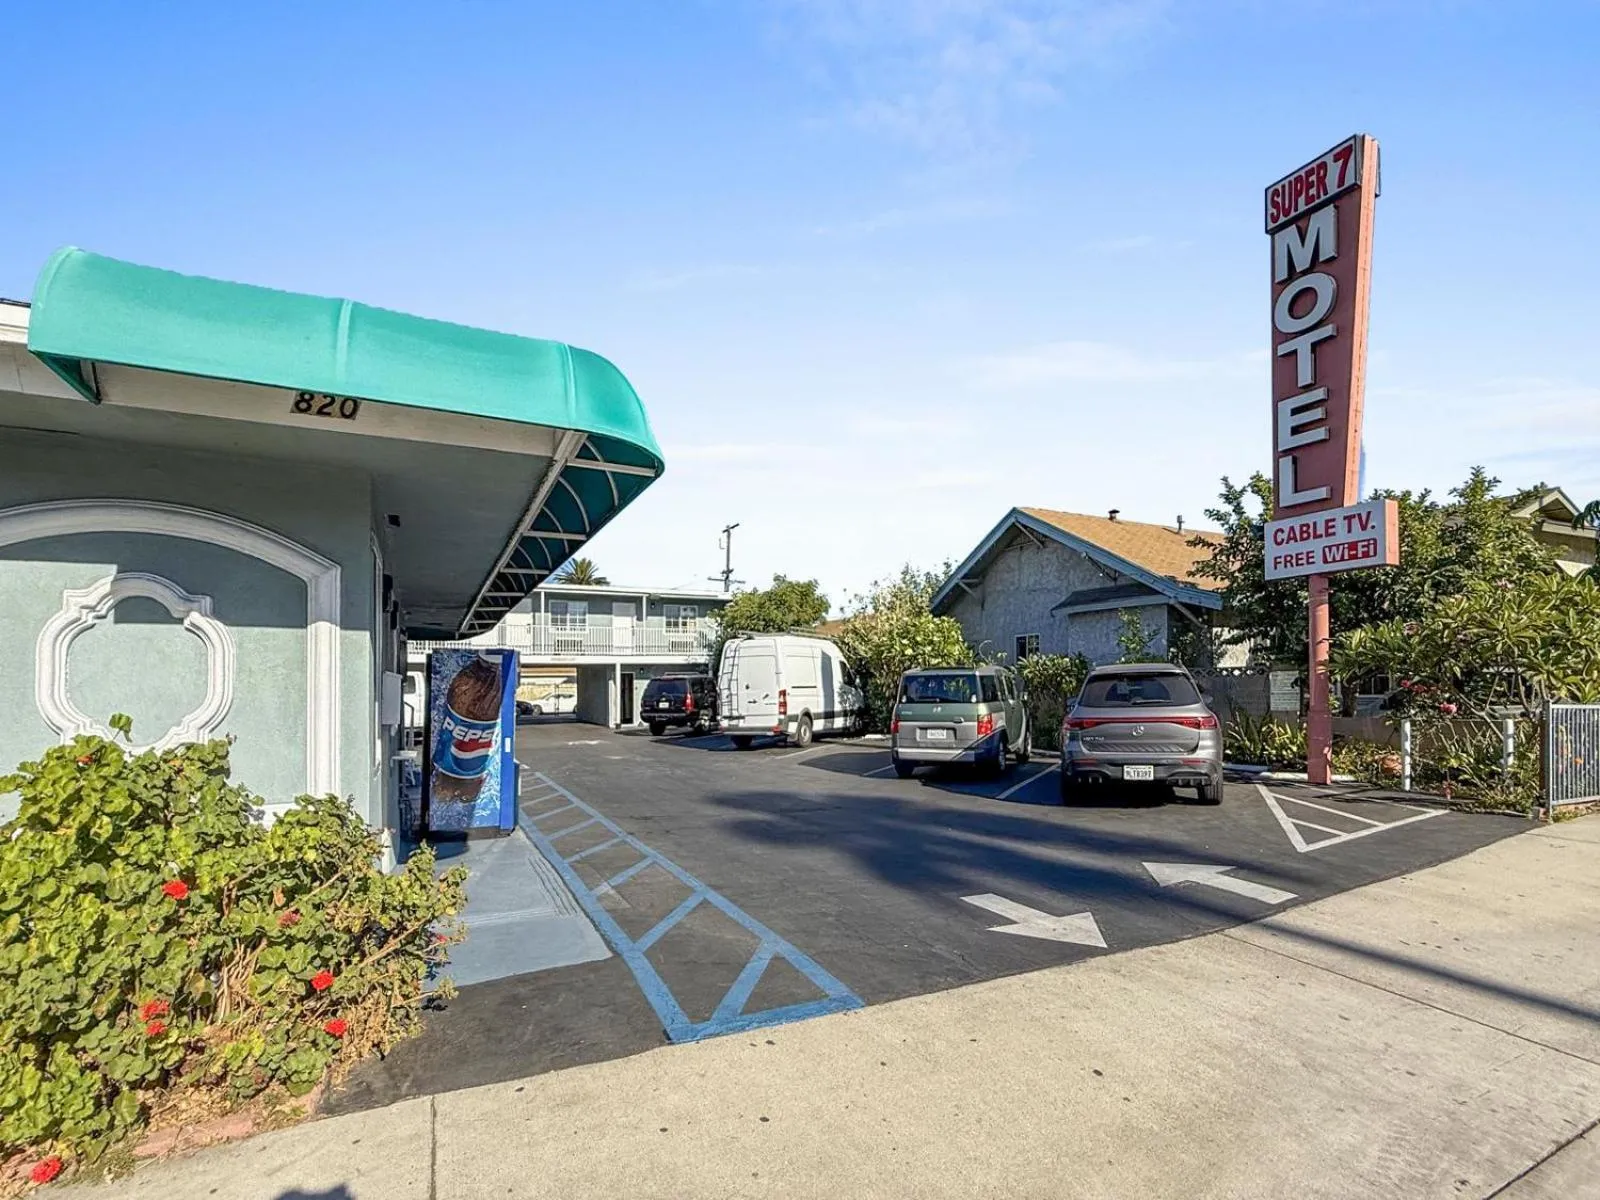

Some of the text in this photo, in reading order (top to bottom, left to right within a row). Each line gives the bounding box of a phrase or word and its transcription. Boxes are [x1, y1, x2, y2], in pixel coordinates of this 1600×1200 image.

[1270, 143, 1353, 224] SUPER 7
[1274, 203, 1337, 508] MOTEL
[295, 391, 358, 418] 820
[1273, 510, 1376, 546] CABLE TV.
[1273, 540, 1375, 570] FREE Wi-Fi
[442, 716, 498, 743] PEPS
